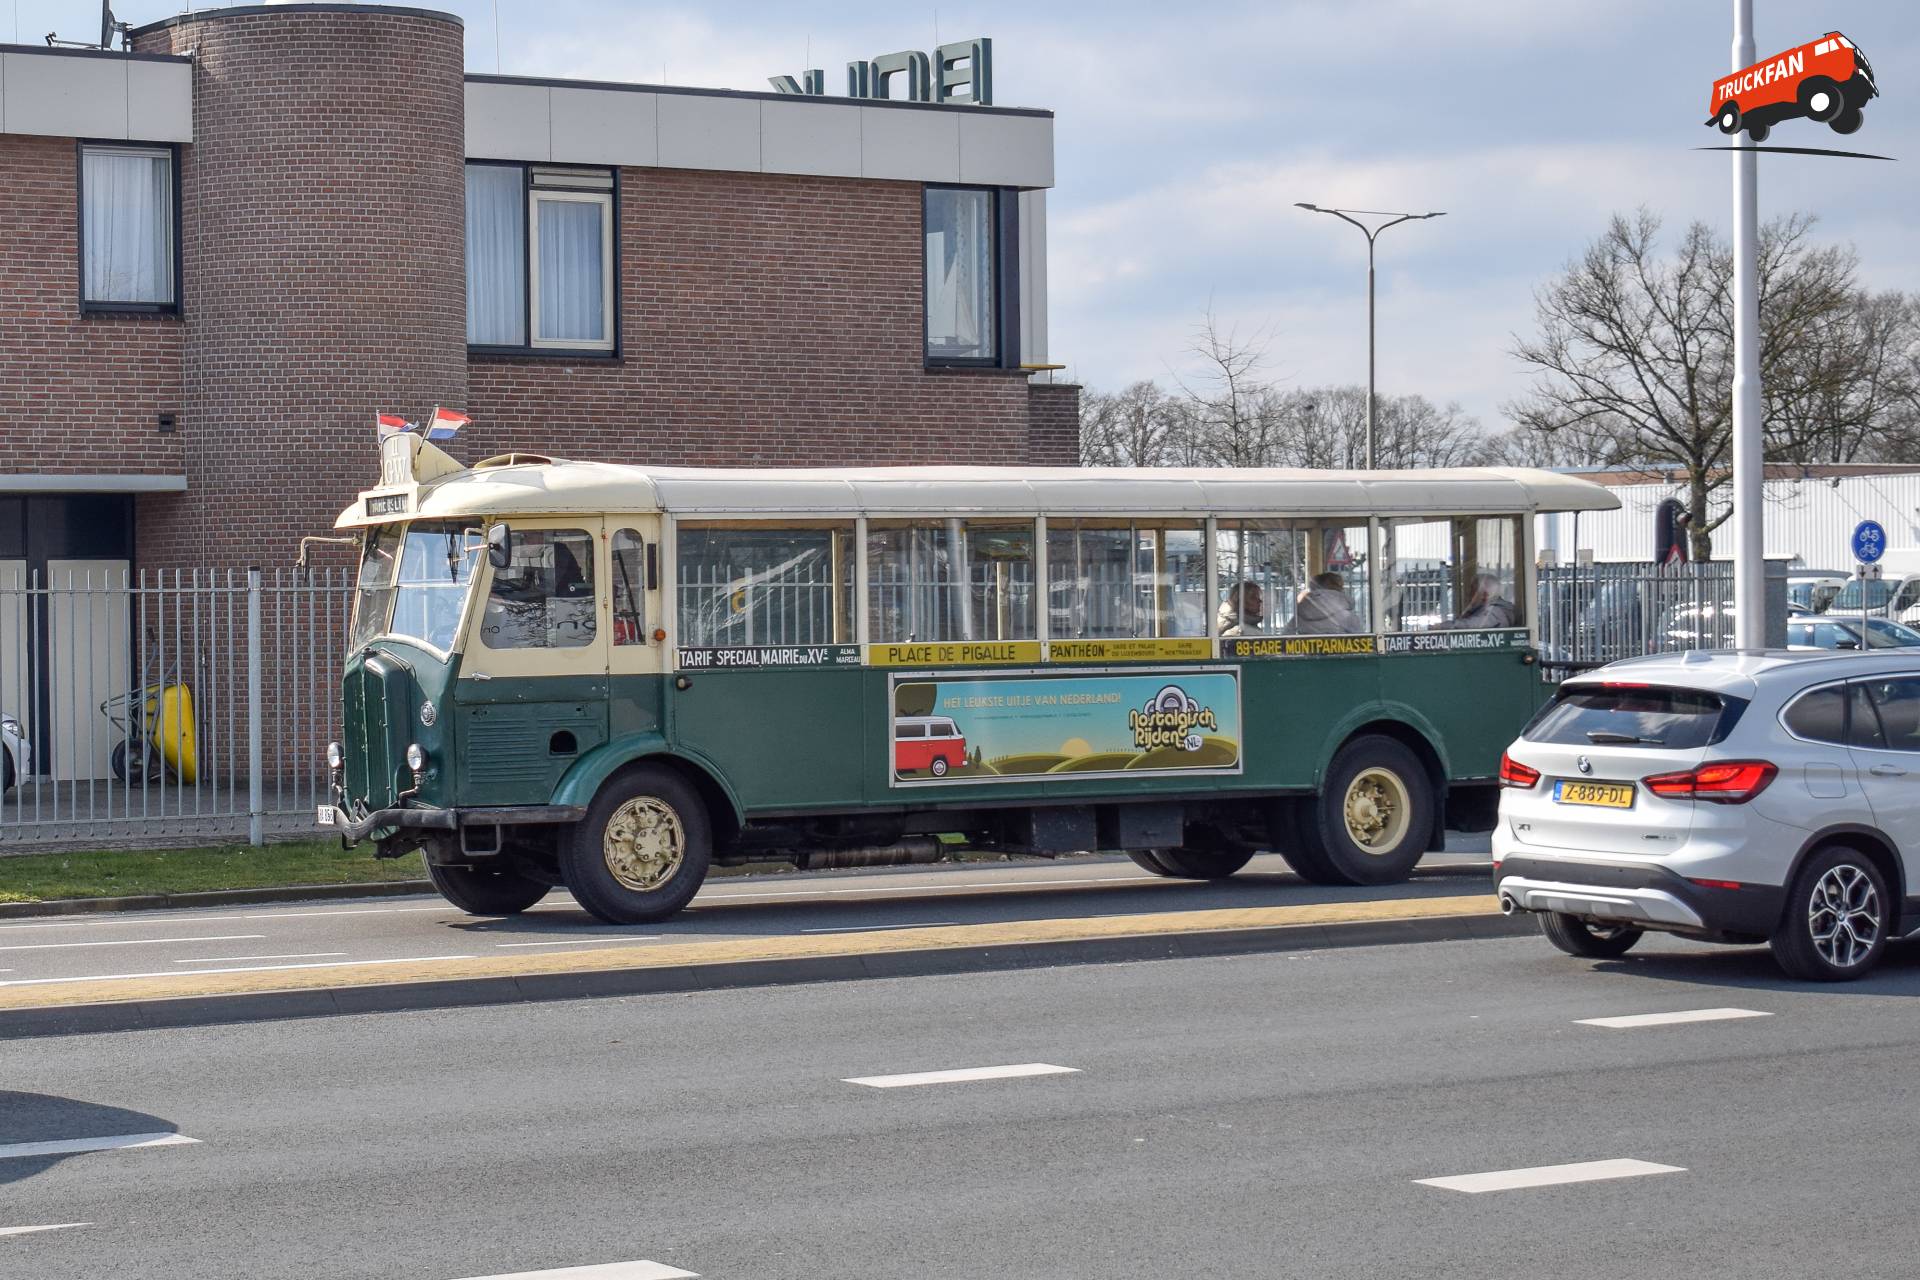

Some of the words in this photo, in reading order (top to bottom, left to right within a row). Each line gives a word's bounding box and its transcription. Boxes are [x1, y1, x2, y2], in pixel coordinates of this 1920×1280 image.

[385, 457, 406, 483] GW
[1285, 638, 1373, 654] MONTPARNASSE
[1384, 636, 1411, 651] TARIF
[1414, 635, 1448, 650] SPECIAL
[1451, 634, 1480, 649] MAIRIE
[680, 650, 713, 667] TARIF
[716, 649, 760, 666] SPECIAL
[761, 648, 800, 665] MAIRIE
[889, 647, 931, 662] PLACE
[939, 647, 954, 661] DE
[963, 645, 1015, 660] PIGALLE
[943, 696, 961, 709] HET
[964, 695, 1004, 708] LEUKSTE
[1006, 694, 1032, 707] UITJE
[1034, 693, 1057, 706] VAN
[1060, 692, 1121, 705] NEDERLAND!
[1565, 784, 1626, 804] Z-889-DL
